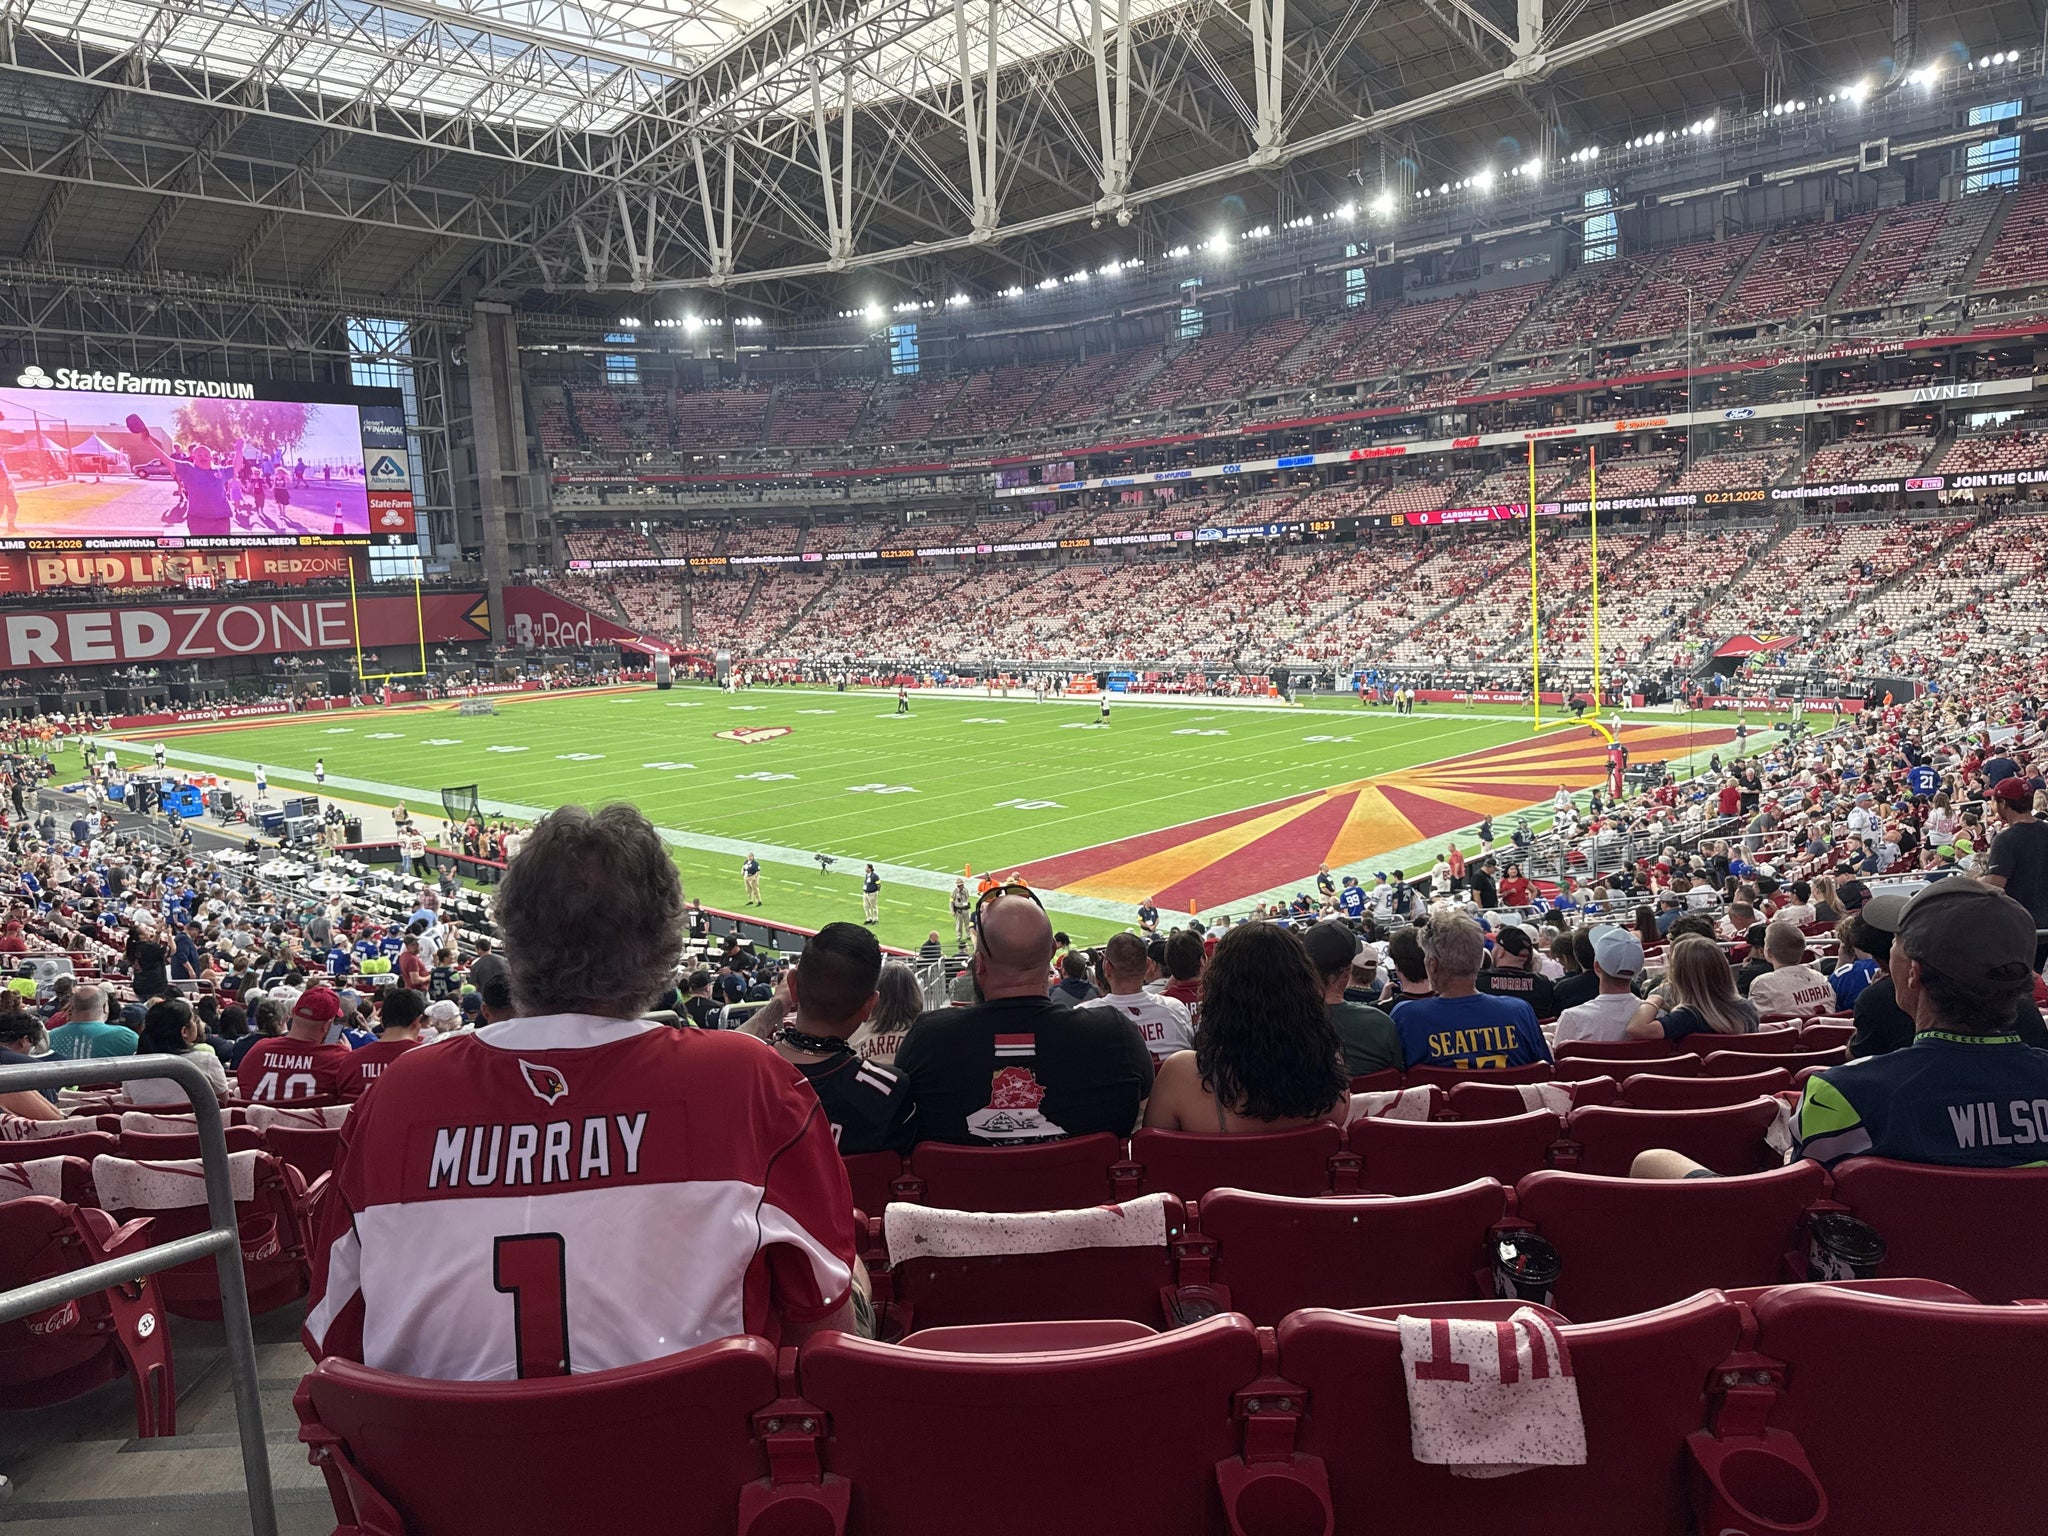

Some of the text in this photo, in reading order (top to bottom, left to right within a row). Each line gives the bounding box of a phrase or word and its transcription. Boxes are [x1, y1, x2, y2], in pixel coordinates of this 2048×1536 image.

[1778, 356, 1800, 365] DICK
[1803, 351, 1836, 362] (NIGHT
[1839, 347, 1875, 358] TRAIN)
[1877, 343, 1904, 353] LANE
[174, 379, 255, 399] STADIUM
[1913, 382, 1982, 402] AVNET
[1405, 403, 1429, 412] LARRY
[1431, 400, 1458, 409] WILSON
[1222, 465, 1241, 474] COX
[1952, 475, 1989, 488] JOIN
[1990, 473, 2016, 486] THE
[1704, 490, 1766, 504] 02.21.2026
[1771, 481, 1900, 500] CardinalsClimb.com
[1563, 502, 1588, 513] HIKE
[1612, 498, 1659, 510] SPECIAL
[1660, 495, 1697, 506] NEEDS
[1441, 509, 1489, 519] CARDINALS
[1310, 521, 1335, 531] 18:31
[29, 540, 82, 549] 02.21.2026
[85, 538, 156, 548] #ClimbWithUs
[186, 538, 209, 547] HIKE
[210, 538, 229, 546] FOR
[229, 538, 267, 546] SPECIAL
[268, 537, 297, 545] NEEDS
[1122, 535, 1148, 544] SPECIAL
[37, 555, 241, 585] BUD LIGHT
[264, 558, 348, 573] REDZONE
[6, 601, 351, 666] REDZONE
[477, 685, 523, 693] CARDINALS
[177, 705, 287, 721] ARIZOA CARDINALS
[1920, 775, 1934, 789] 21
[90, 817, 99, 826] 12
[1346, 894, 1360, 907] 99
[1491, 977, 1533, 991] MURRAY
[1793, 985, 1831, 1005] MURRAY
[1428, 1025, 1519, 1057] SEATTLE
[263, 1053, 313, 1070] TILLMAN
[1947, 1099, 2048, 1148] WILSO
[428, 1112, 650, 1189] MURRAY
[493, 1232, 571, 1380] 1
[143, 1318, 152, 1331] 31
